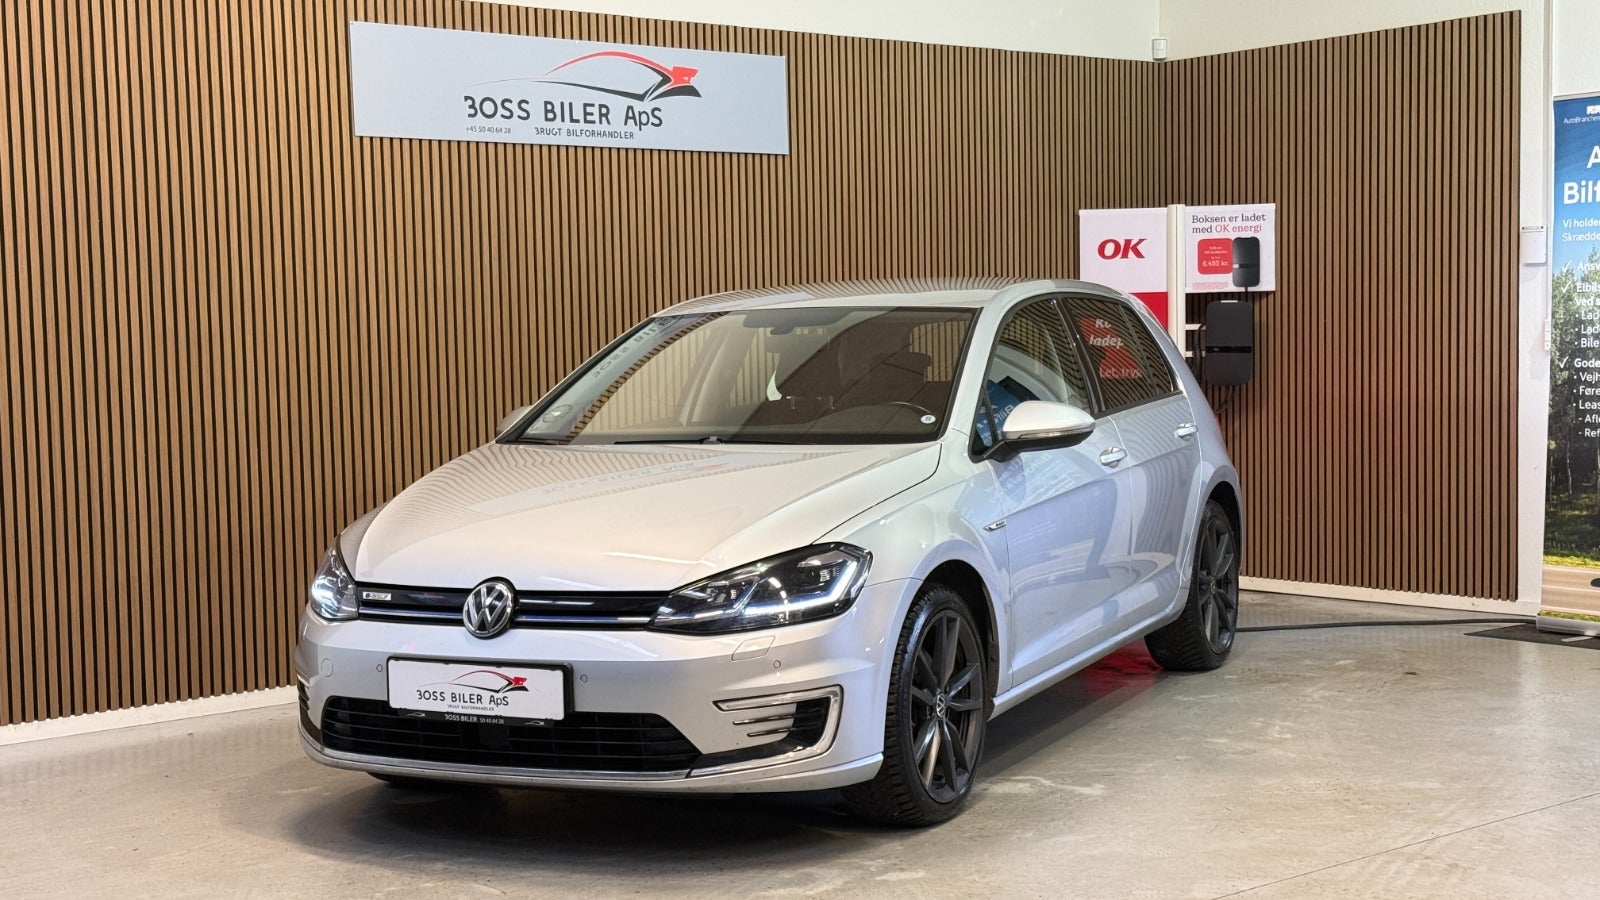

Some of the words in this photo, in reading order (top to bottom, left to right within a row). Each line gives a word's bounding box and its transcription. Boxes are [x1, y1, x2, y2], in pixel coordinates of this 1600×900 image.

[464, 95, 530, 120] BOSS
[543, 101, 611, 126] BILER
[623, 105, 663, 131] ApS
[534, 127, 562, 136] BRUGT
[566, 129, 634, 140] BILFORHANDLER
[1192, 214, 1226, 224] Boksen
[1241, 213, 1266, 222] ladet
[1562, 218, 1572, 228] Vi
[1192, 225, 1212, 234] med
[1215, 224, 1230, 233] OK
[1232, 223, 1262, 234] energi
[1098, 238, 1147, 260] OK
[1574, 294, 1594, 306] ved
[416, 690, 446, 702] BOSS
[451, 692, 483, 704] BILER
[489, 695, 509, 707] ApS
[461, 715, 478, 723] BILER
